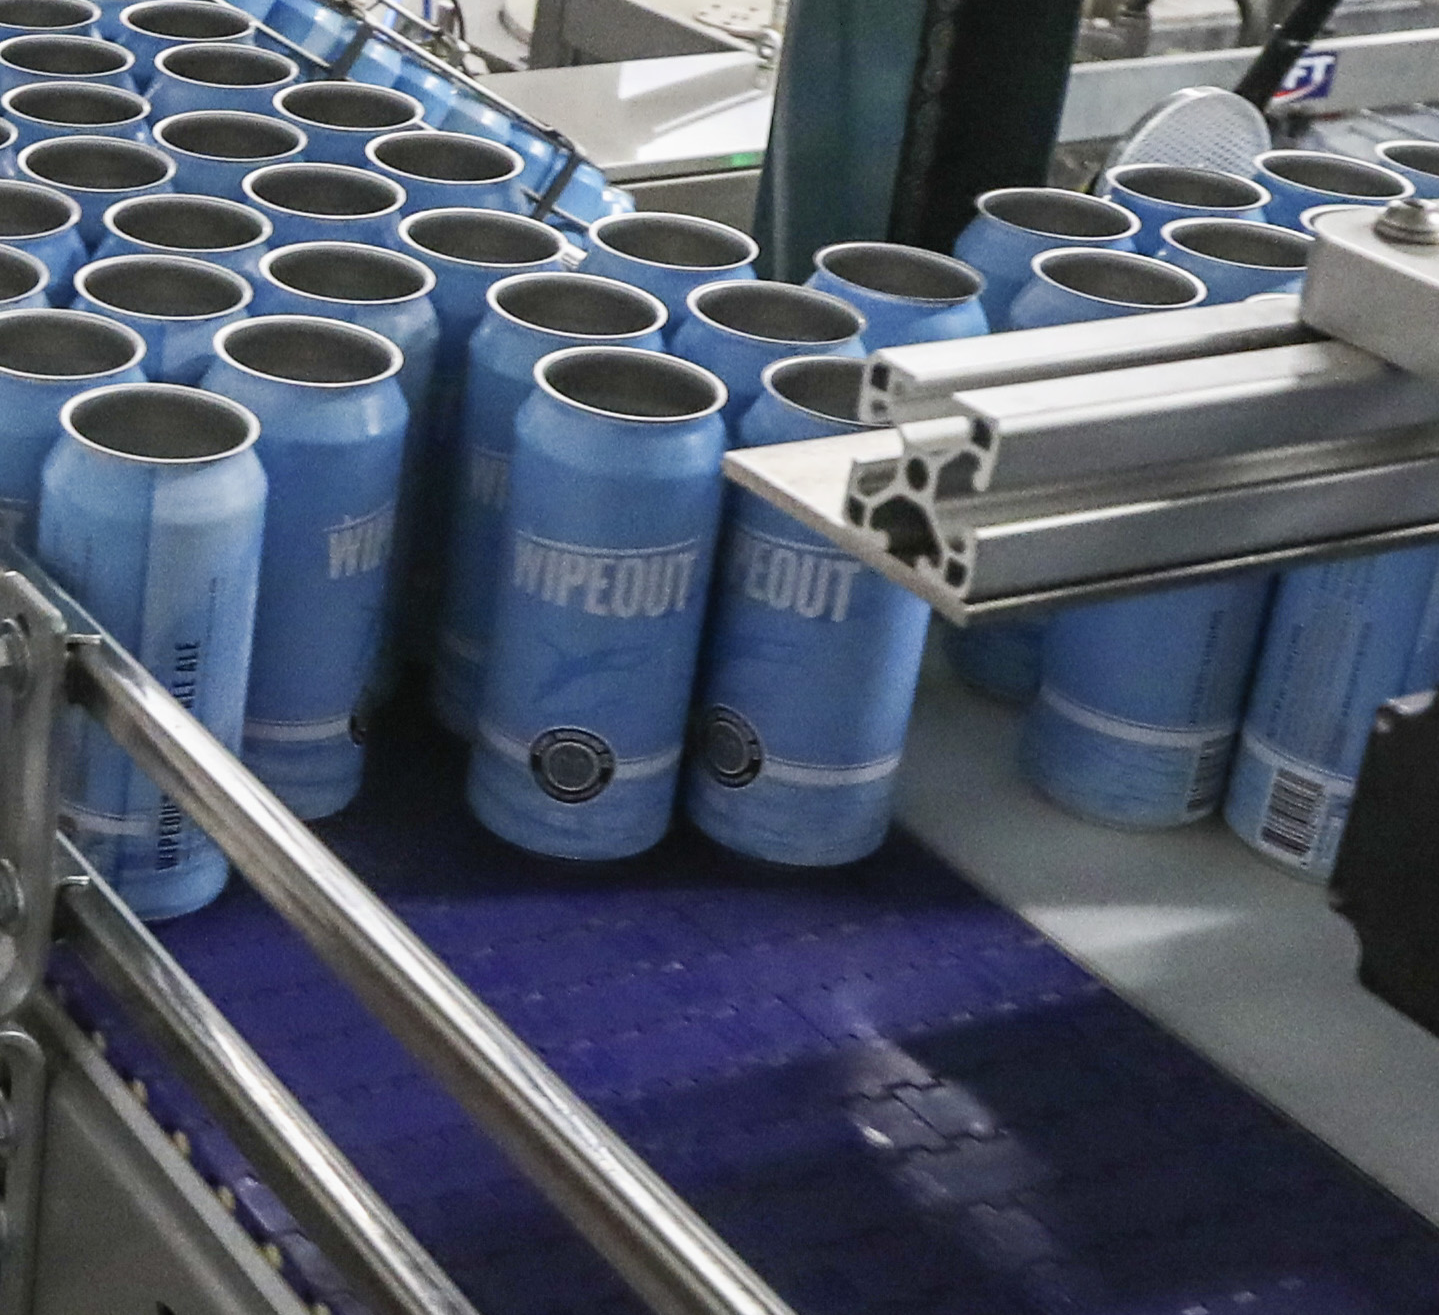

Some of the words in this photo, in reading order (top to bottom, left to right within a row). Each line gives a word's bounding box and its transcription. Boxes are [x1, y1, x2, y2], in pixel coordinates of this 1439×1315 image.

[1282, 55, 1337, 90] FT
[513, 538, 702, 619] WIPEOUT
[739, 539, 861, 623] EOUT
[175, 639, 201, 673] ALE
